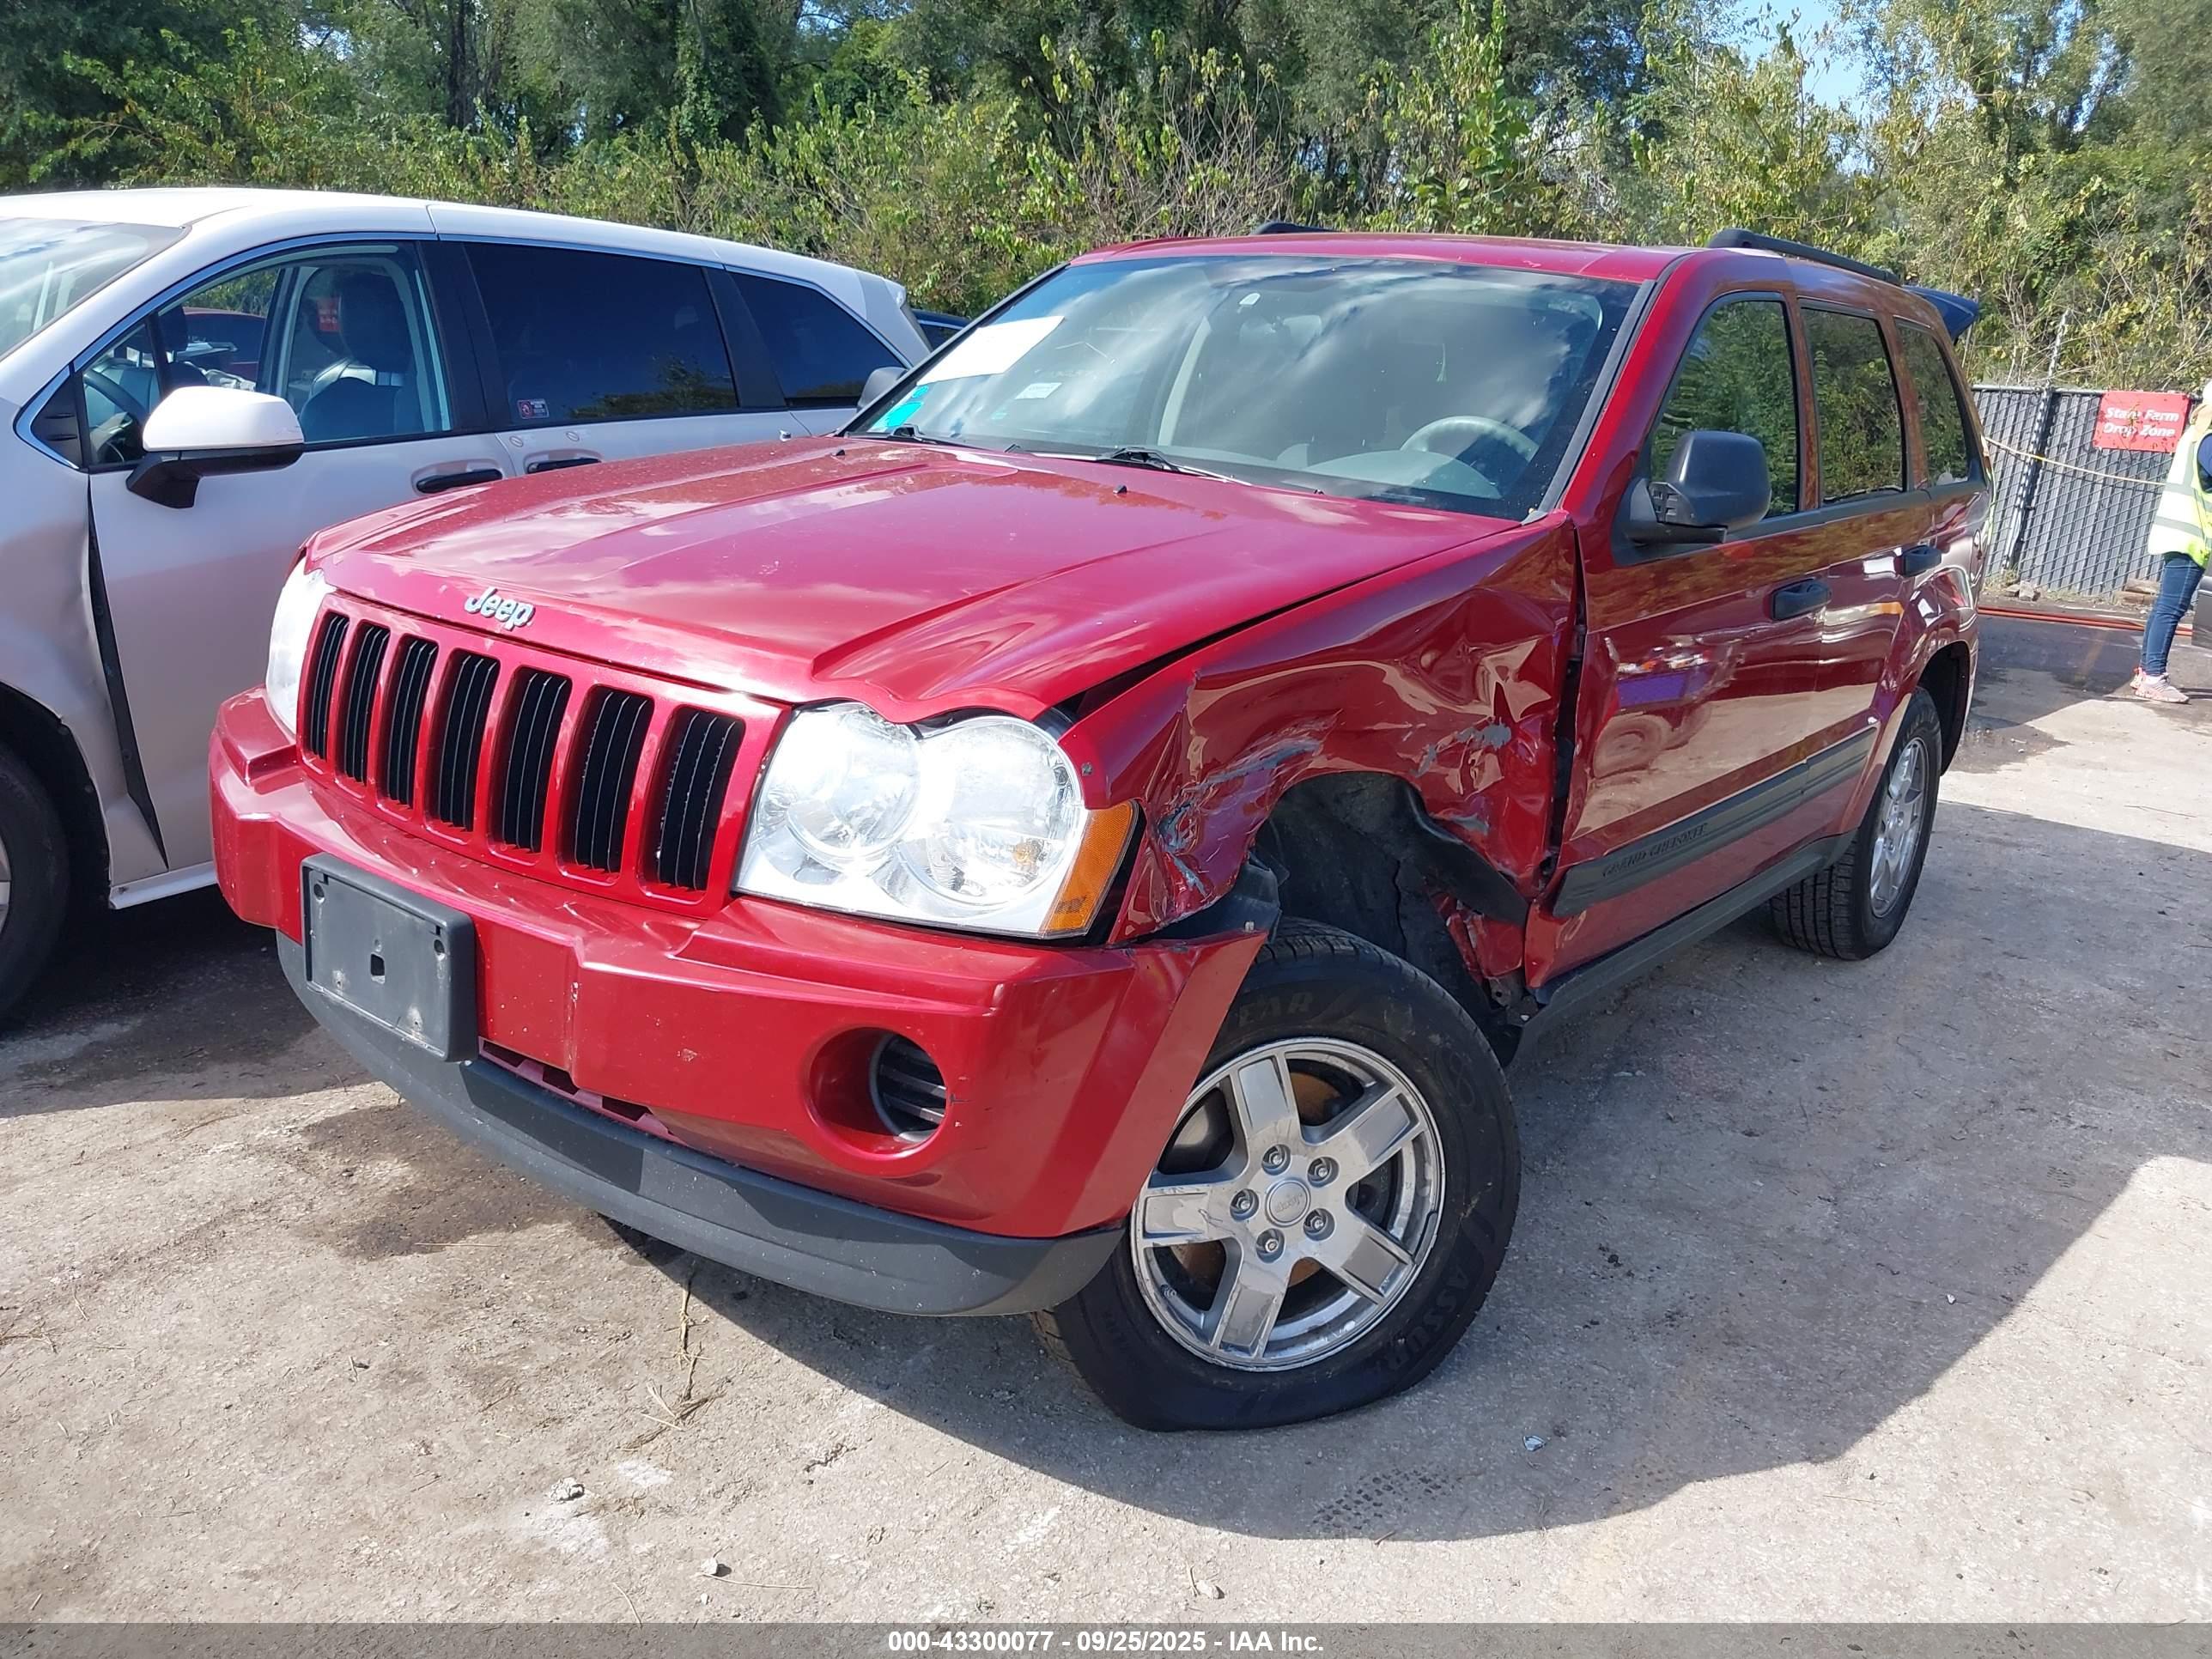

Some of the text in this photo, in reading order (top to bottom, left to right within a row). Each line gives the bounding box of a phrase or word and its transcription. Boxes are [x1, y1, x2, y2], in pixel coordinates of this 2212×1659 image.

[2145, 408, 2179, 422] Farm
[2103, 422, 2175, 437] Drop Zone
[465, 586, 536, 631] Jeep
